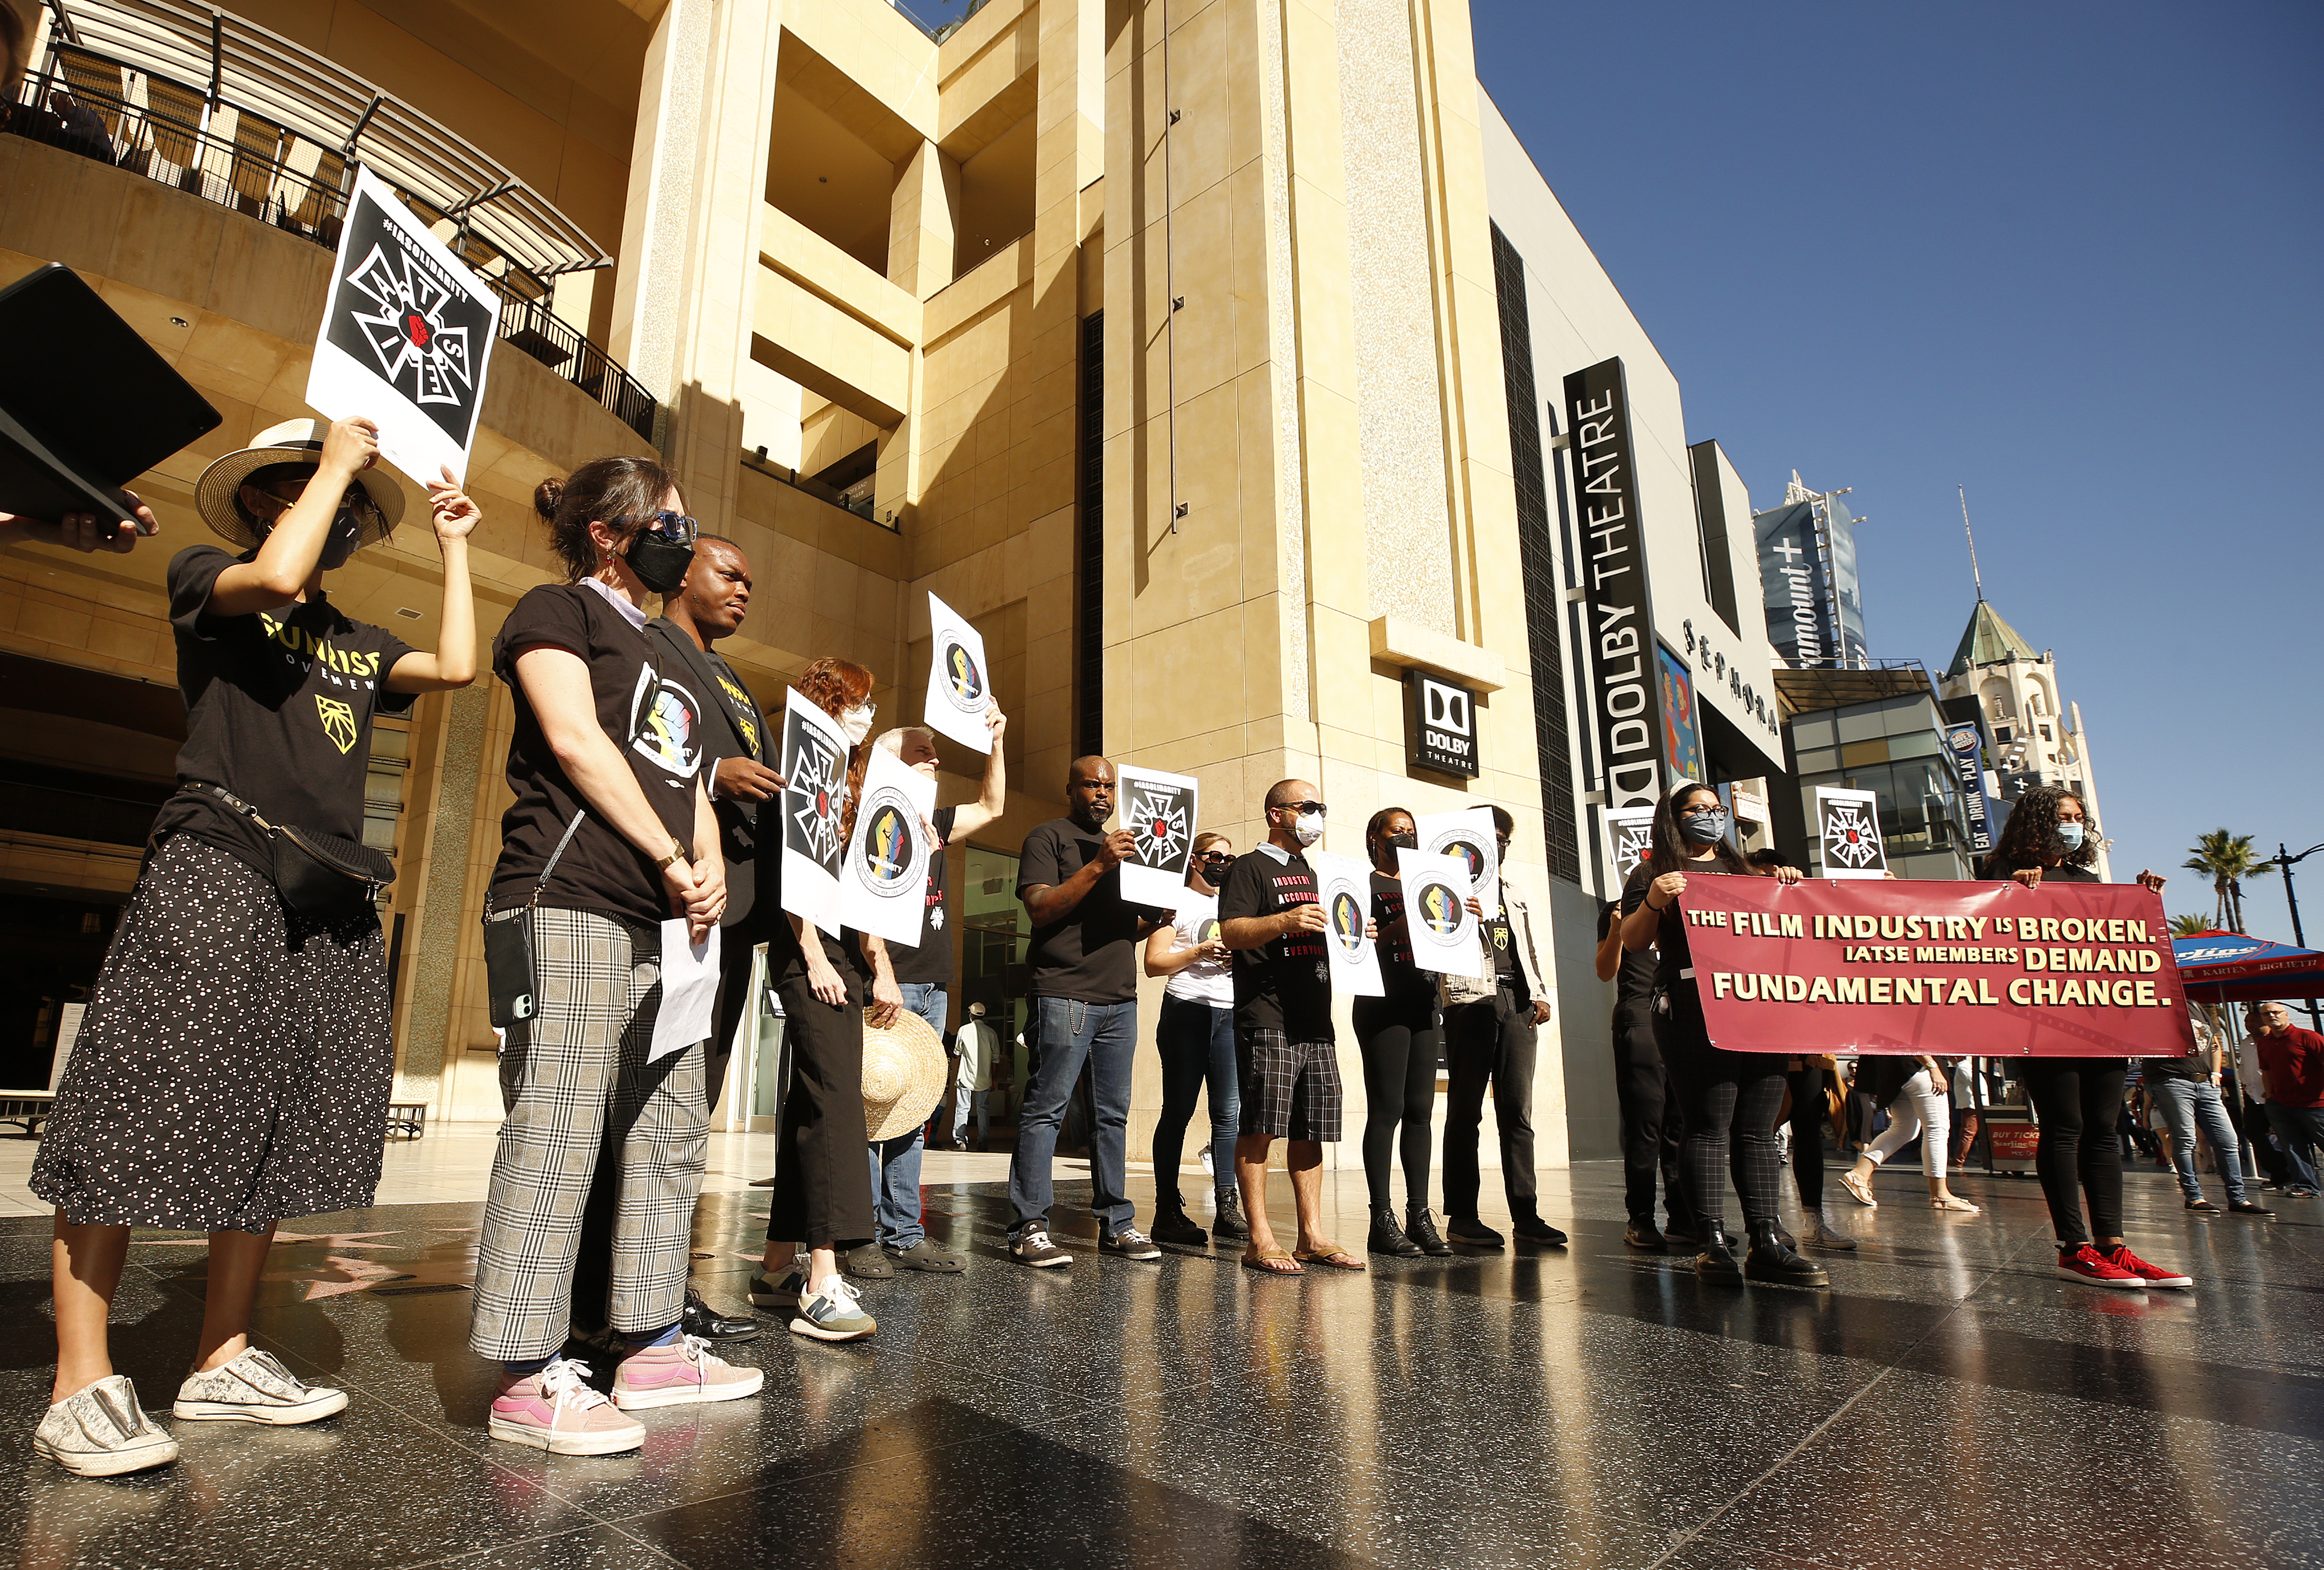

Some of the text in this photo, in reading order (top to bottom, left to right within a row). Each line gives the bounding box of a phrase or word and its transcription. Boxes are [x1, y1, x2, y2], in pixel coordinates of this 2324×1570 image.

[382, 218, 469, 303] #IASOLIDARITY
[1576, 389, 1650, 755] DOLBY THEATRE
[1773, 537, 1823, 669] ramount+
[286, 654, 374, 691] OVEMEN
[1683, 619, 1778, 737] SEPHORA
[801, 720, 841, 759] #IASOLIDARITY
[1425, 730, 1471, 756] DOLBY
[1426, 751, 1473, 770] THEATRE
[1134, 780, 1182, 796] #IASOLIDARITY
[1959, 758, 1991, 849] EAT DRINK PLAY
[1618, 817, 1654, 827] #IASOLIDARIT
[1272, 875, 1311, 888] INDUSTRY
[1687, 910, 2156, 943] THE FILM INDUSTRY IS BROKEN.
[1283, 945, 1325, 957] EVERYONE
[1844, 946, 2161, 973] IATSE MEMBERS DEMAND
[2174, 946, 2258, 961] rline
[2203, 966, 2247, 976] KARTEN
[2260, 960, 2317, 971] BIGLIETTI
[1711, 972, 2172, 1007] FUNDAMENTAL CHANGE.
[1993, 1140, 2028, 1148] Starline
